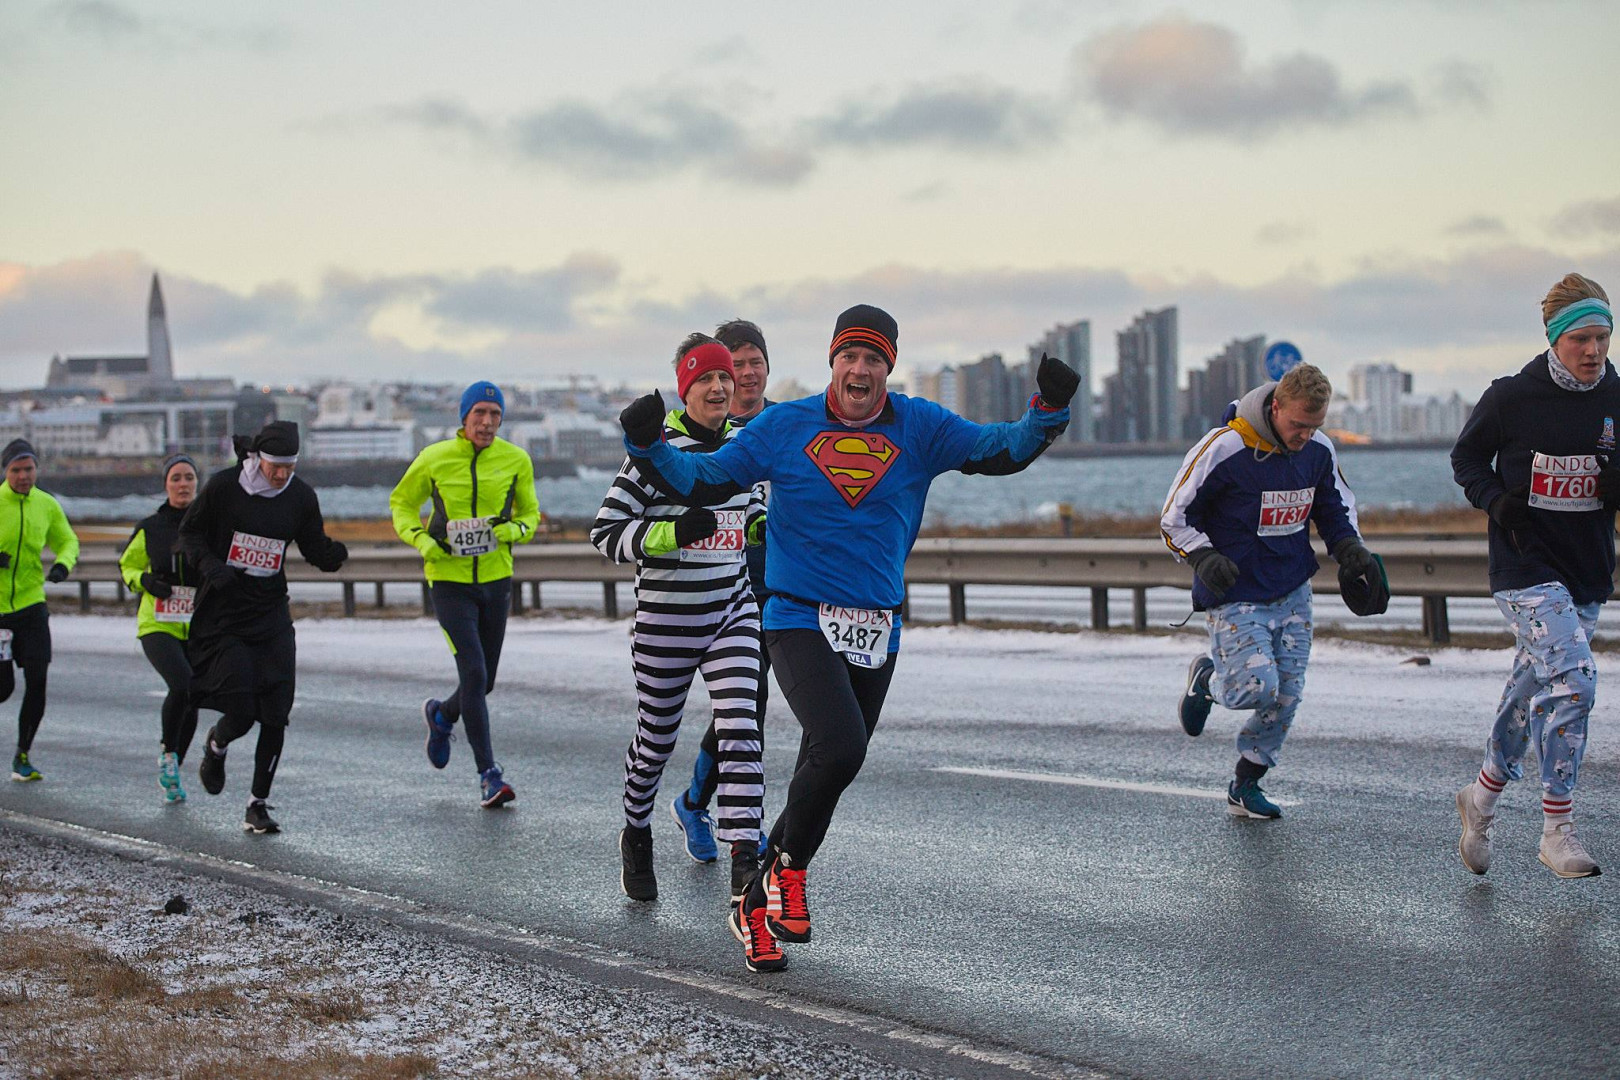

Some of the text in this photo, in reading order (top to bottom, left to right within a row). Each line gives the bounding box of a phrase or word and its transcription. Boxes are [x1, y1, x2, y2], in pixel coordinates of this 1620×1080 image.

[1262, 489, 1313, 504] LINDEX
[1543, 476, 1597, 498] 1760
[715, 512, 743, 525] DEX
[1270, 505, 1306, 525] 1737
[234, 533, 284, 551] LINDEX
[454, 528, 492, 546] 4871
[235, 547, 276, 568] 3095
[820, 602, 891, 628] LINDEX
[828, 621, 883, 651] 3487
